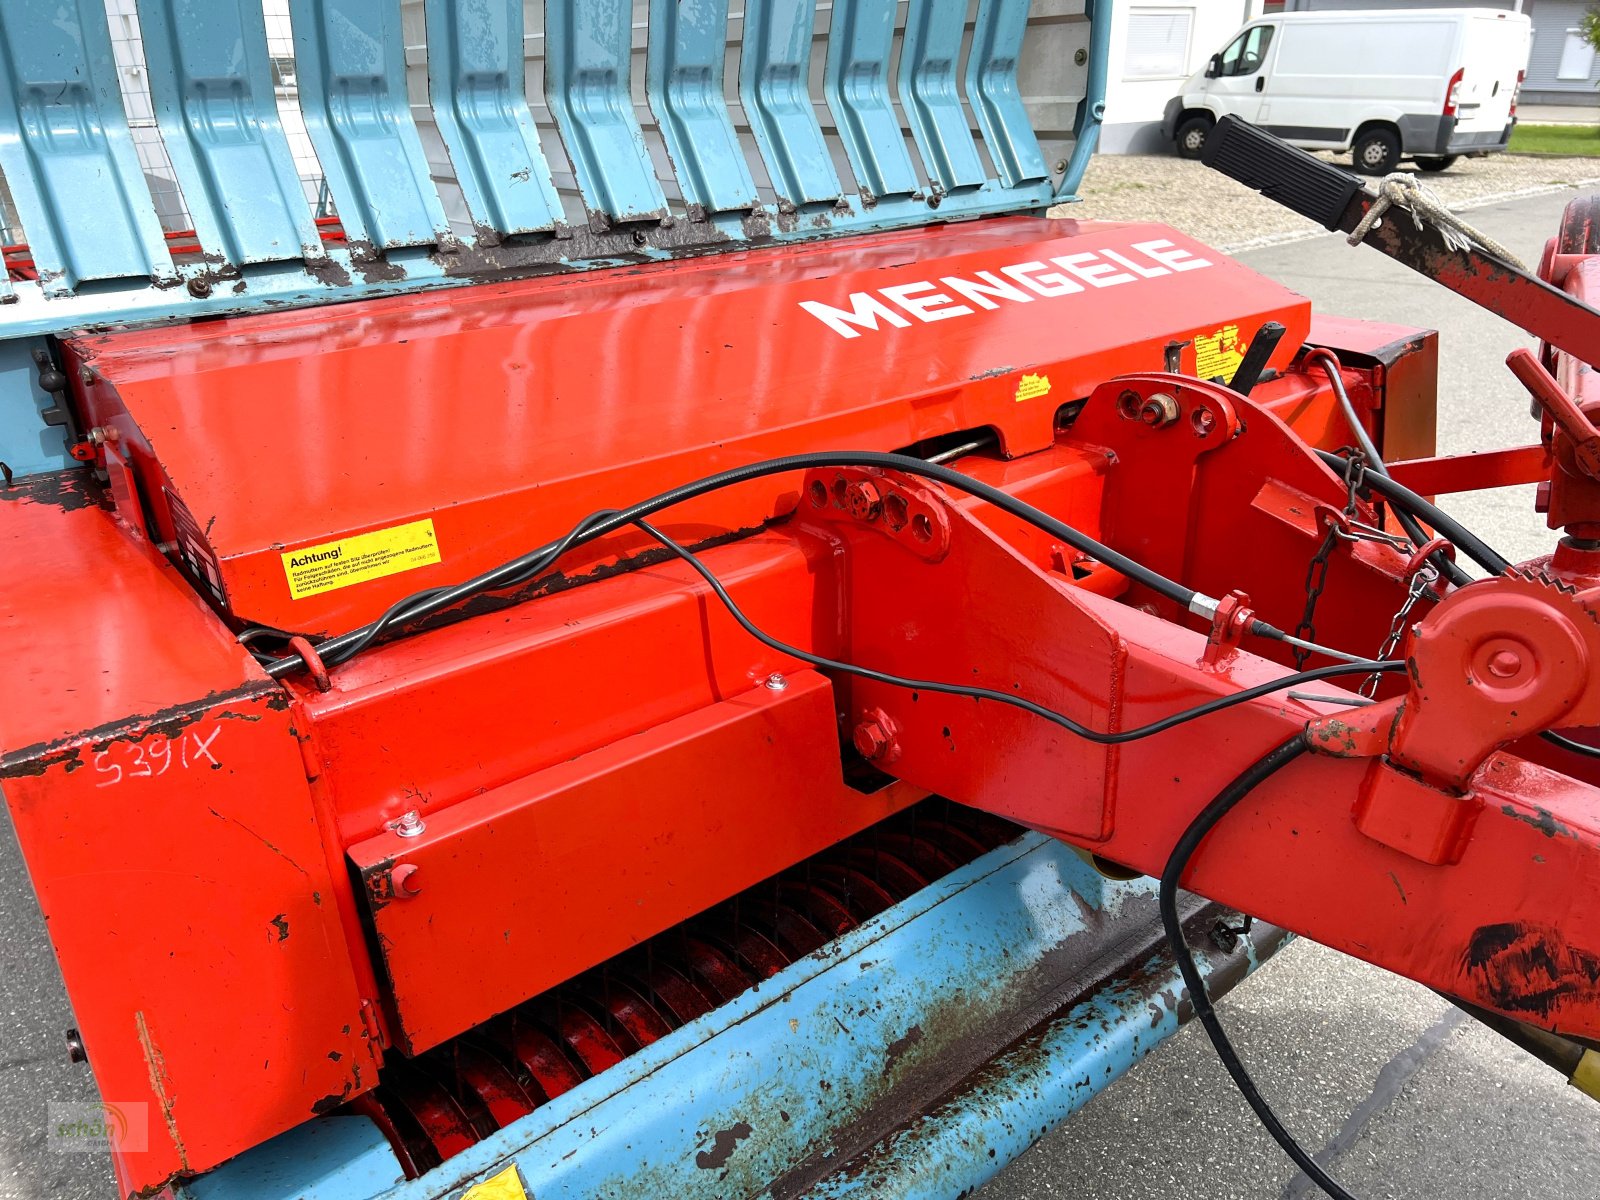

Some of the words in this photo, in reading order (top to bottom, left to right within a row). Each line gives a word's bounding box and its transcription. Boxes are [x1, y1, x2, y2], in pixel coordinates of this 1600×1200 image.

[798, 238, 1213, 339] MENGELE
[290, 546, 342, 568] Achtung!
[374, 551, 404, 562] angezogene
[292, 566, 323, 577] Radmuttern
[295, 574, 335, 588] zurückzuführen
[349, 562, 381, 574] übernehmen
